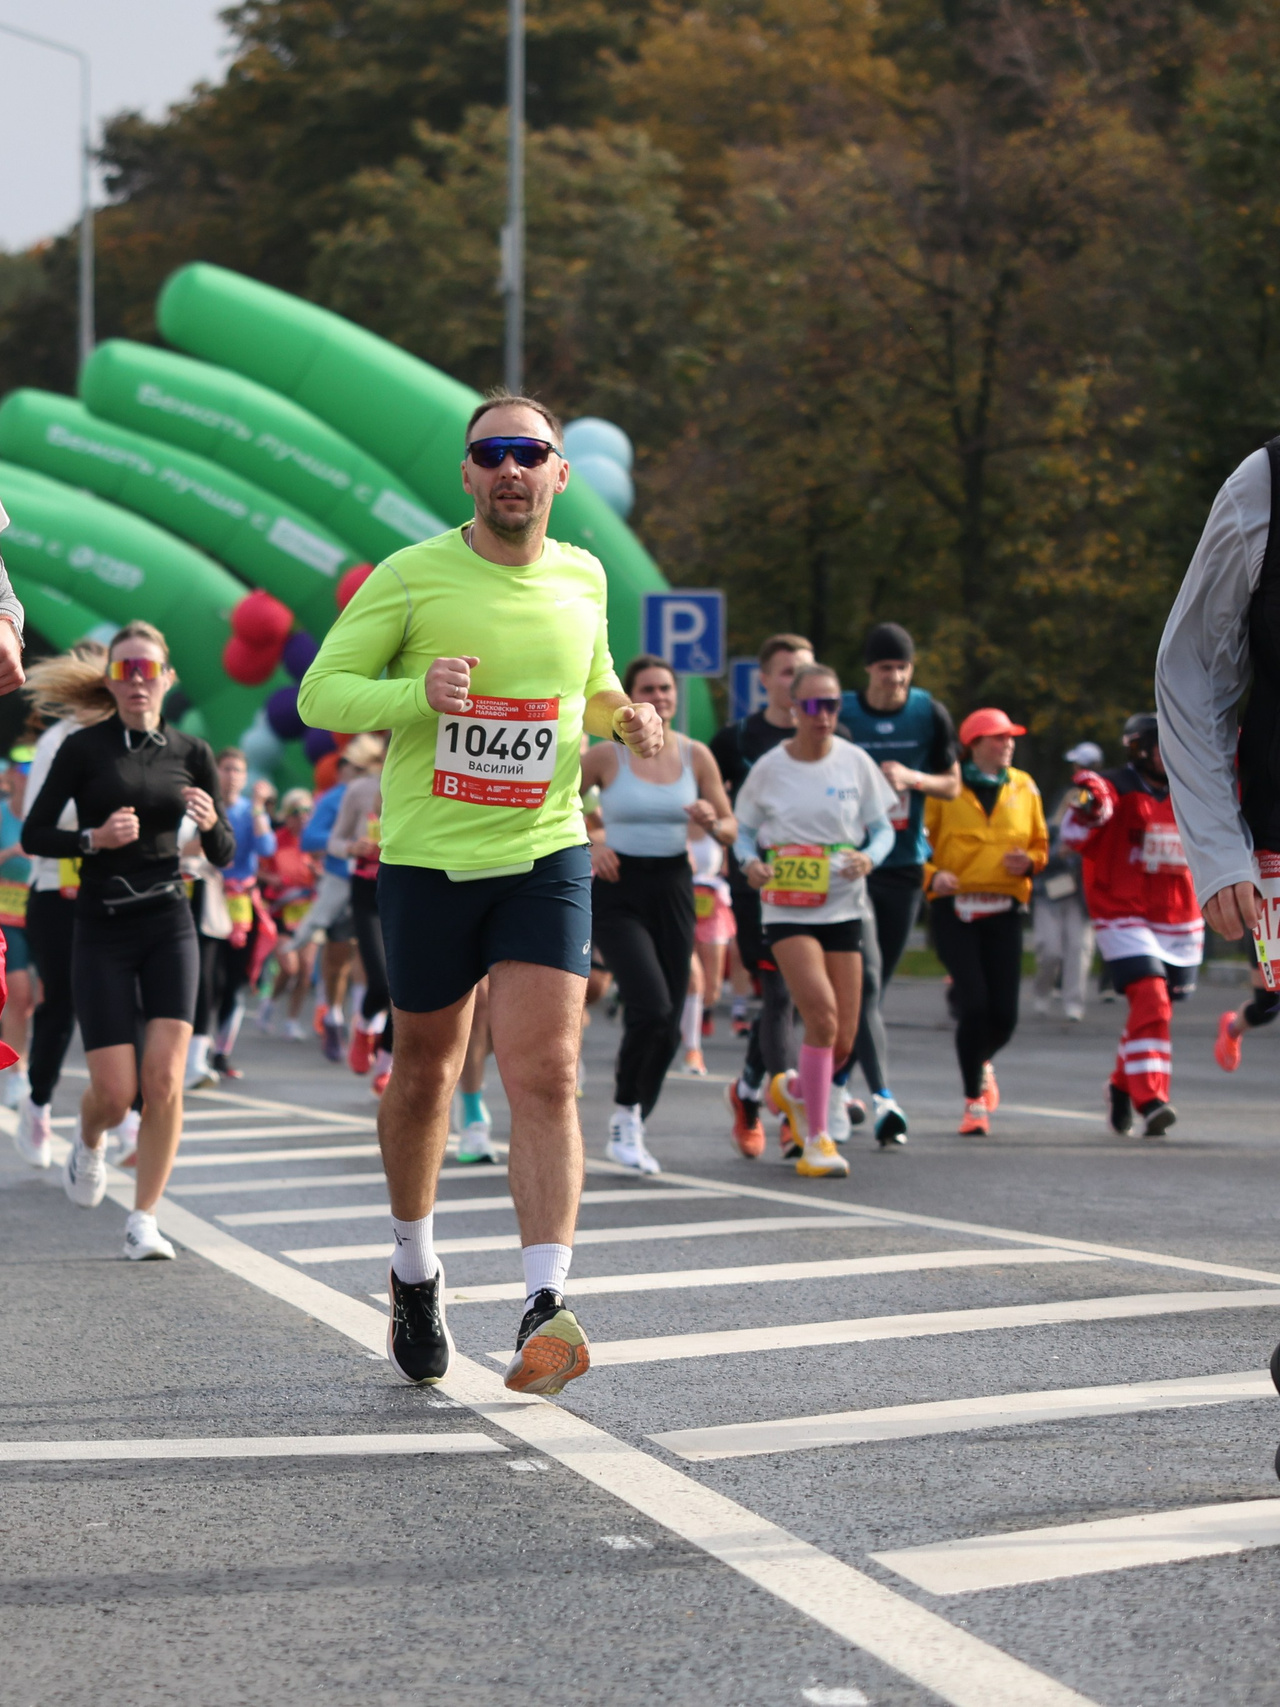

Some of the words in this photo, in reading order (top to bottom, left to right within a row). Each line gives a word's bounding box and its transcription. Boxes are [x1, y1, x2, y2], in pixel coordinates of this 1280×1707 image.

[662, 601, 707, 666] P
[475, 704, 519, 713] МОСКОВСКИЙ
[475, 709, 508, 717] МАРАФОН
[445, 722, 553, 761] 10469
[468, 761, 524, 775] ВАСИЛИЙ
